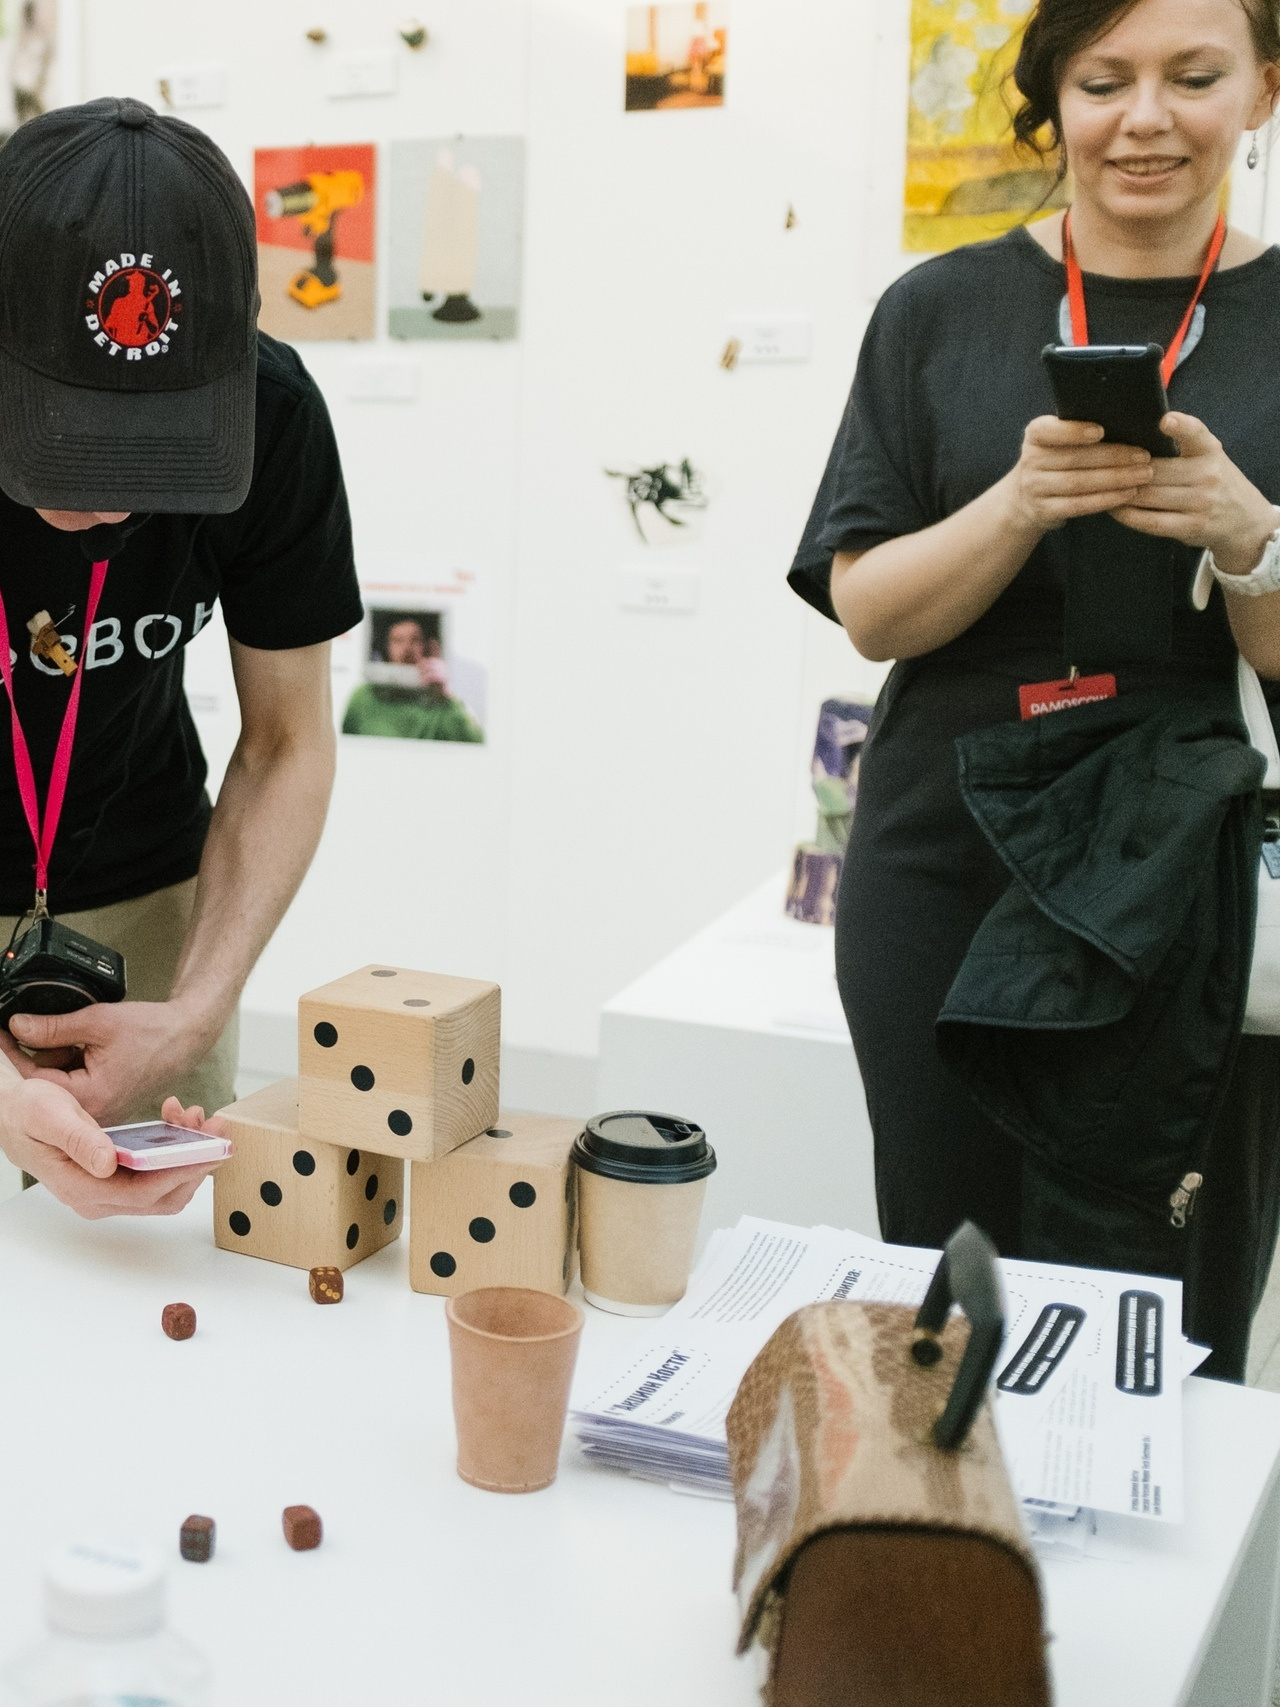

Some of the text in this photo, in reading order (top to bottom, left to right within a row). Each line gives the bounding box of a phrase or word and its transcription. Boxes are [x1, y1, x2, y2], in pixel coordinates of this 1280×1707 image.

[88, 253, 182, 298] MADE IN
[85, 313, 179, 361] DETROIT
